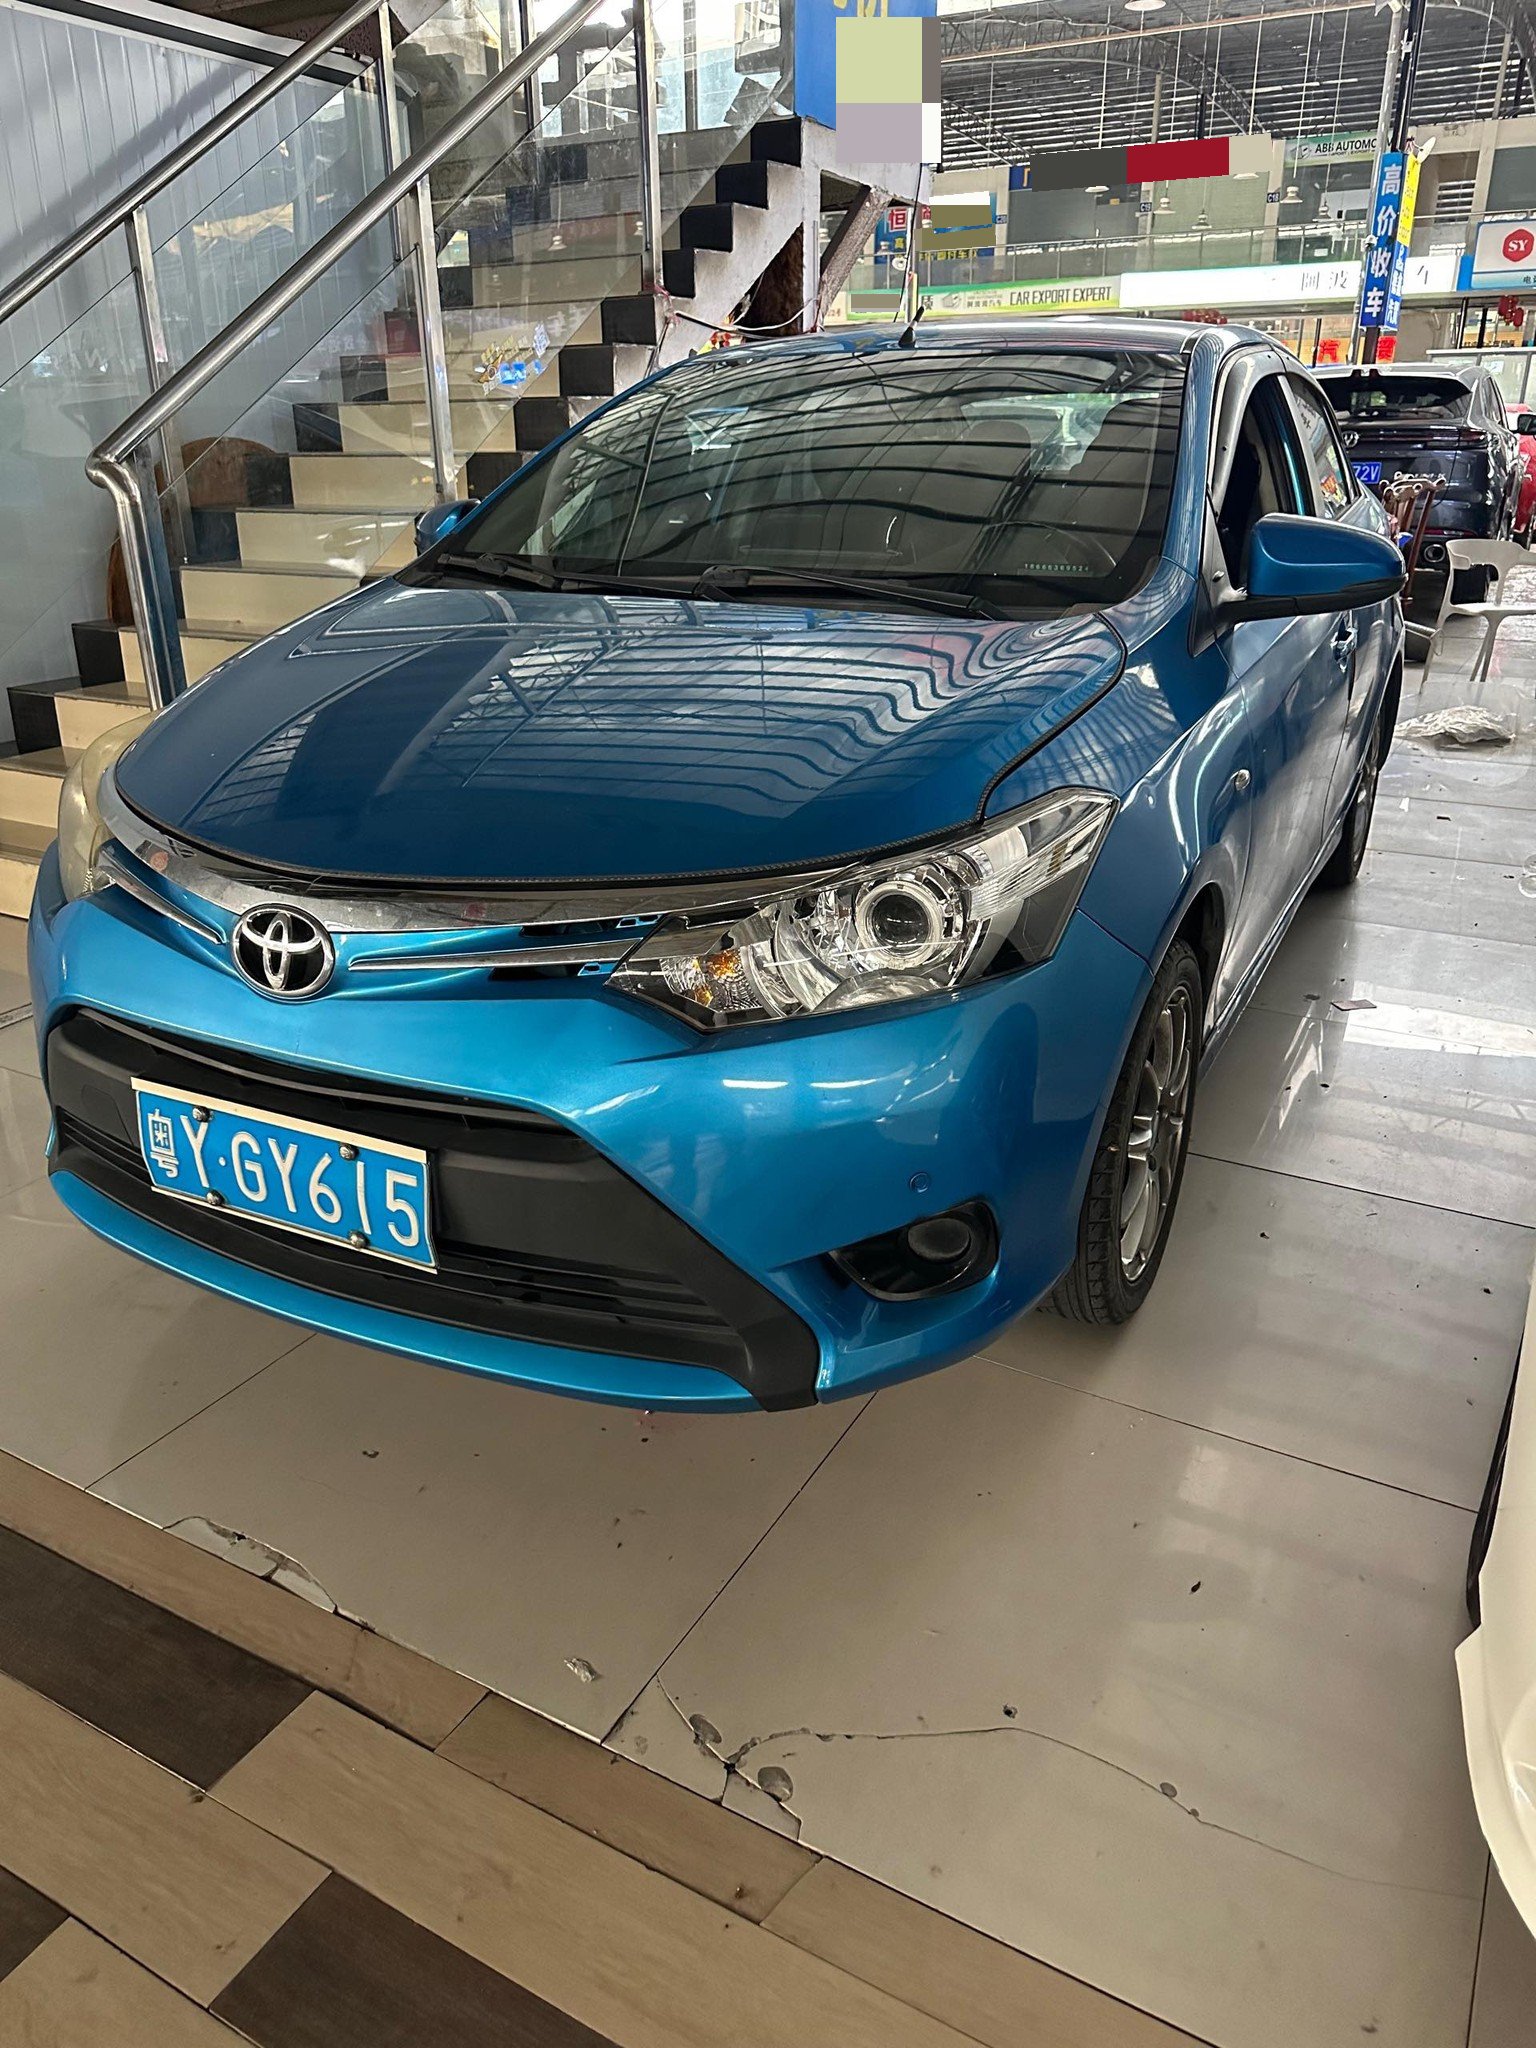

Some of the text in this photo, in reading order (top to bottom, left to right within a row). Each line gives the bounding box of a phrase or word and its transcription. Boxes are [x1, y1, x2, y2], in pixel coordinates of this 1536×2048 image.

[1365, 163, 1402, 318] 高价收车
[1508, 239, 1529, 252] SY
[1010, 290, 1030, 306] CAR
[1032, 288, 1071, 304] EXPORT
[1073, 286, 1112, 302] EXPERT
